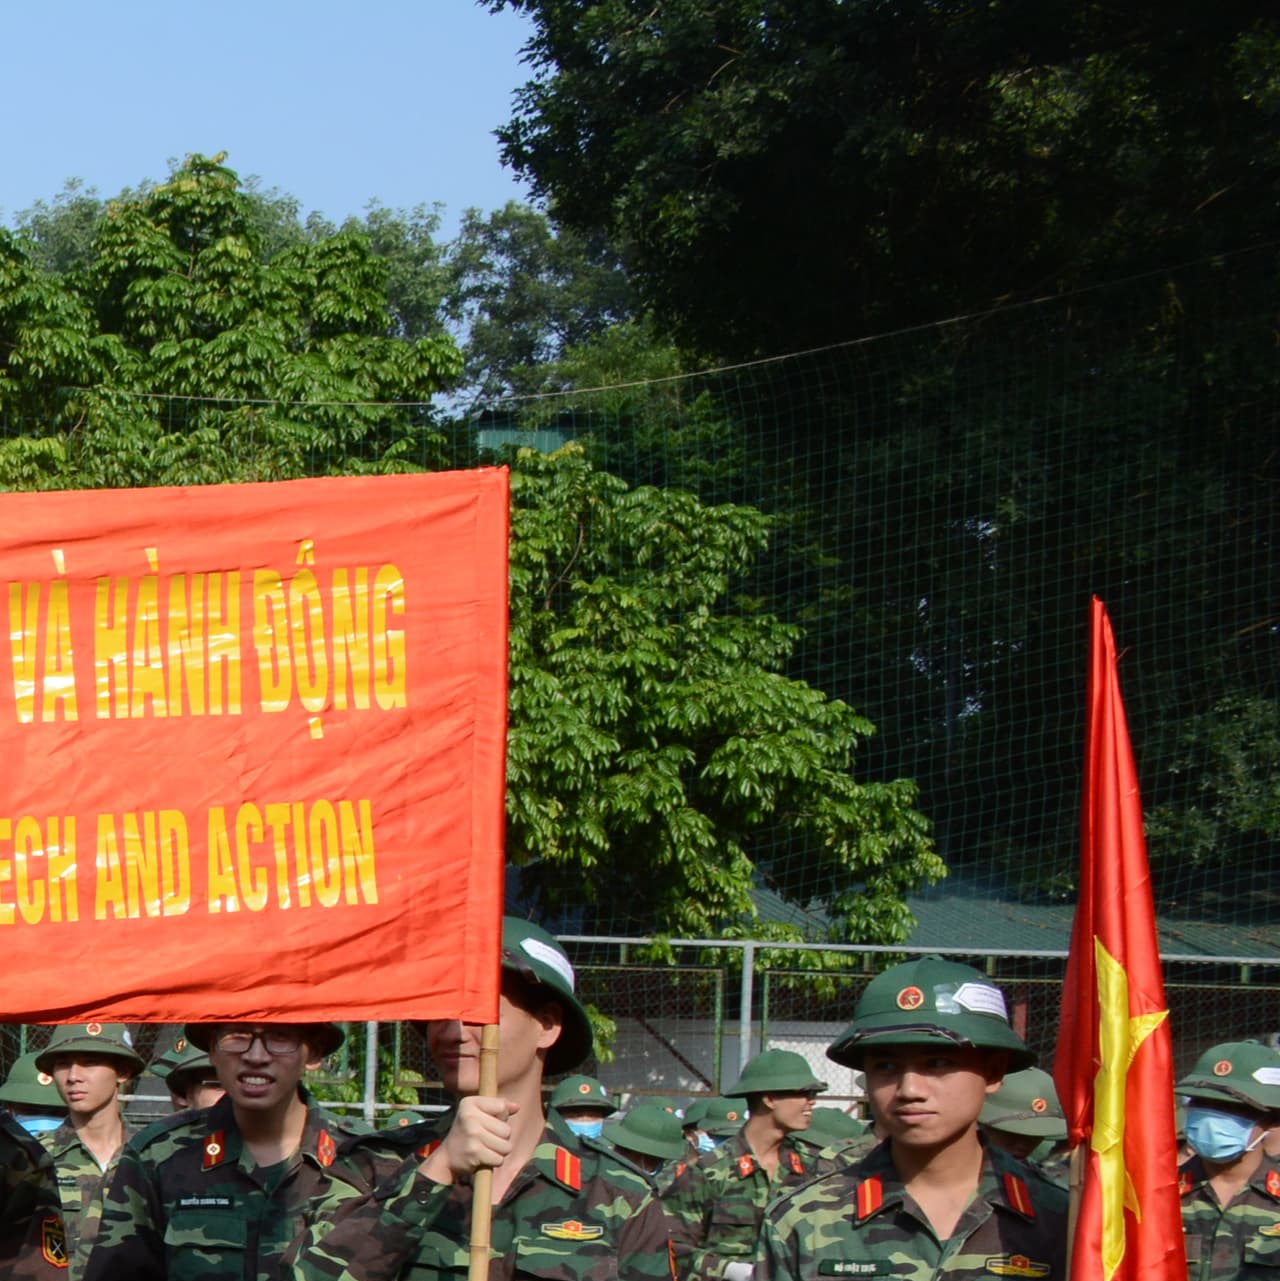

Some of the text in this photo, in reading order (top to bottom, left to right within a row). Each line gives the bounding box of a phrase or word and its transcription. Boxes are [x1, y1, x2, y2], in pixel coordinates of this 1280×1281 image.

[9, 549, 79, 723] VÀ
[94, 548, 242, 720] HÀNH
[252, 539, 407, 739] ĐỘNG
[95, 808, 191, 920] AND
[207, 799, 378, 914] ACTION
